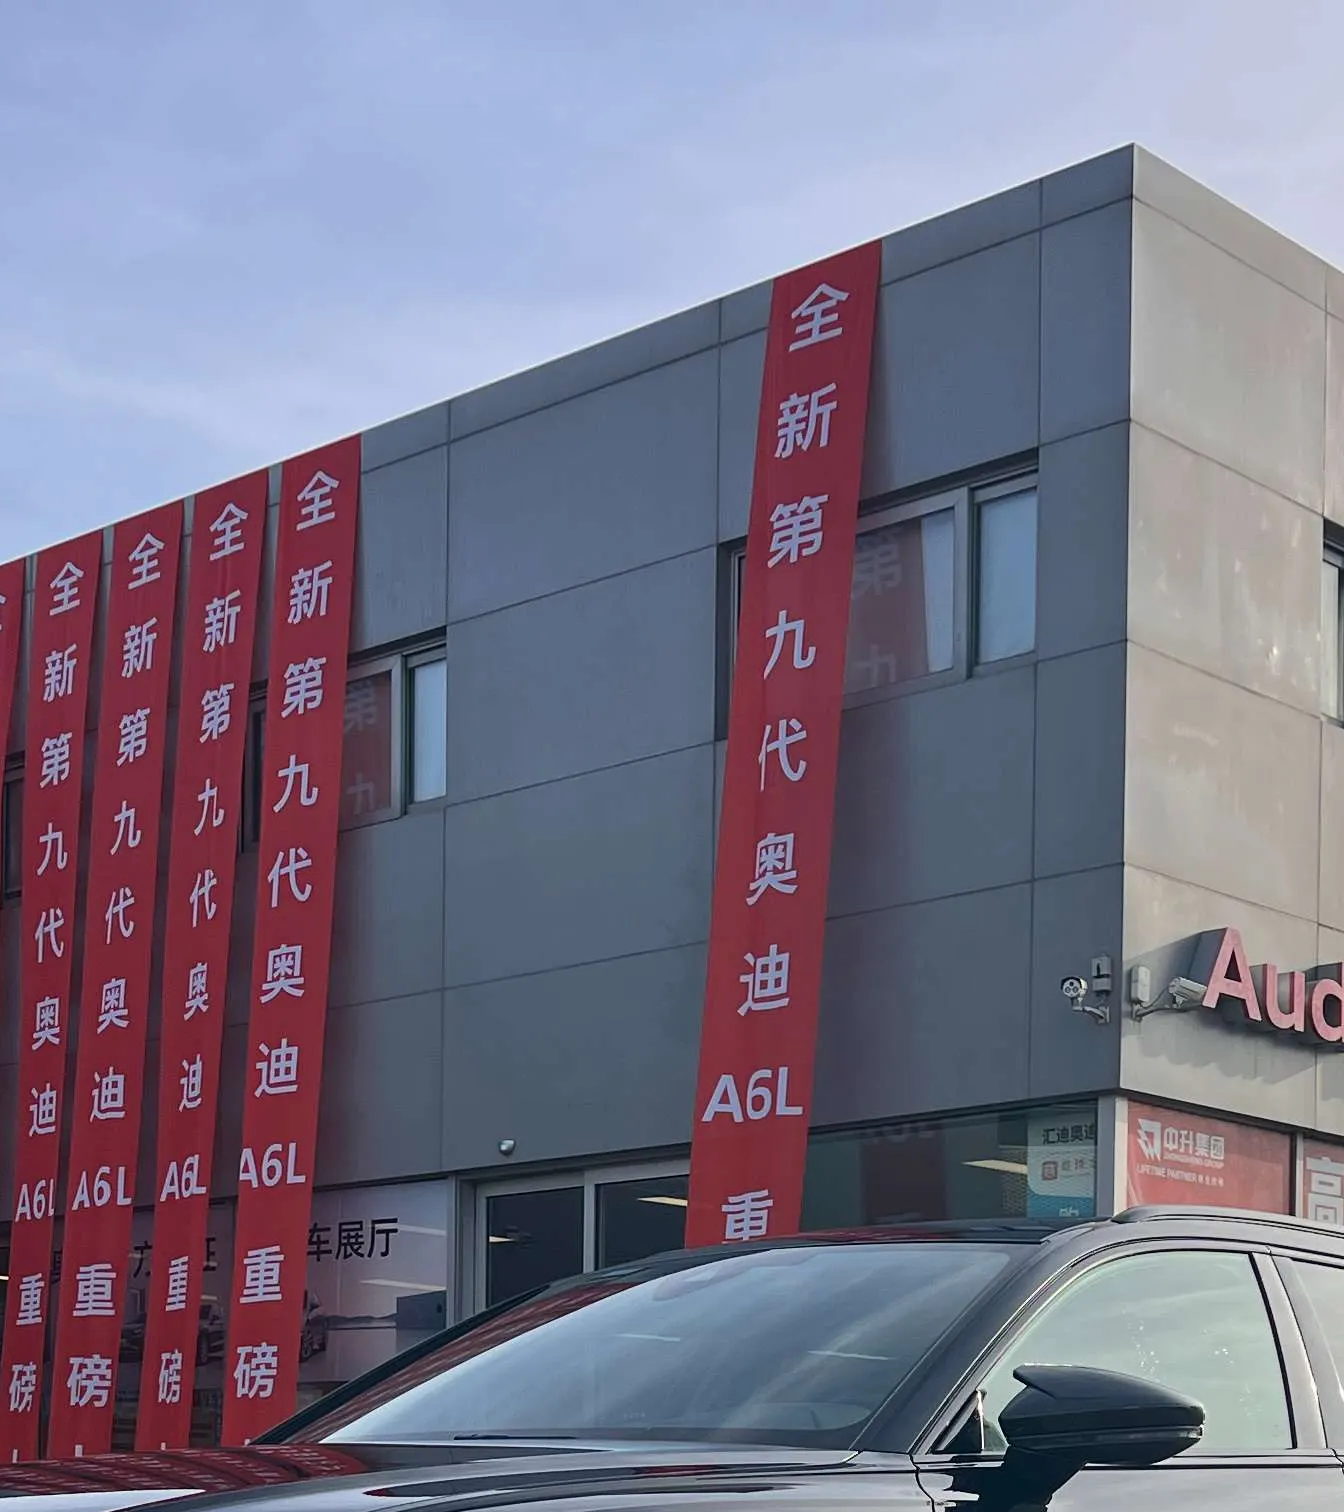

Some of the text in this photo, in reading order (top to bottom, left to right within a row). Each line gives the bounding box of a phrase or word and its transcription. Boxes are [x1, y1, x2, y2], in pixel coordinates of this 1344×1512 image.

[9, 562, 84, 1463] 全新第九代奥迪A6L重磅
[67, 533, 166, 1457] 全新第九代奥迪A6L重磅
[157, 502, 248, 1449] 全新第九代奥迪A6L重磅
[234, 470, 340, 1446] 全新第九代奥迪A6L重磅
[1164, 1126, 1225, 1160] 中升集团
